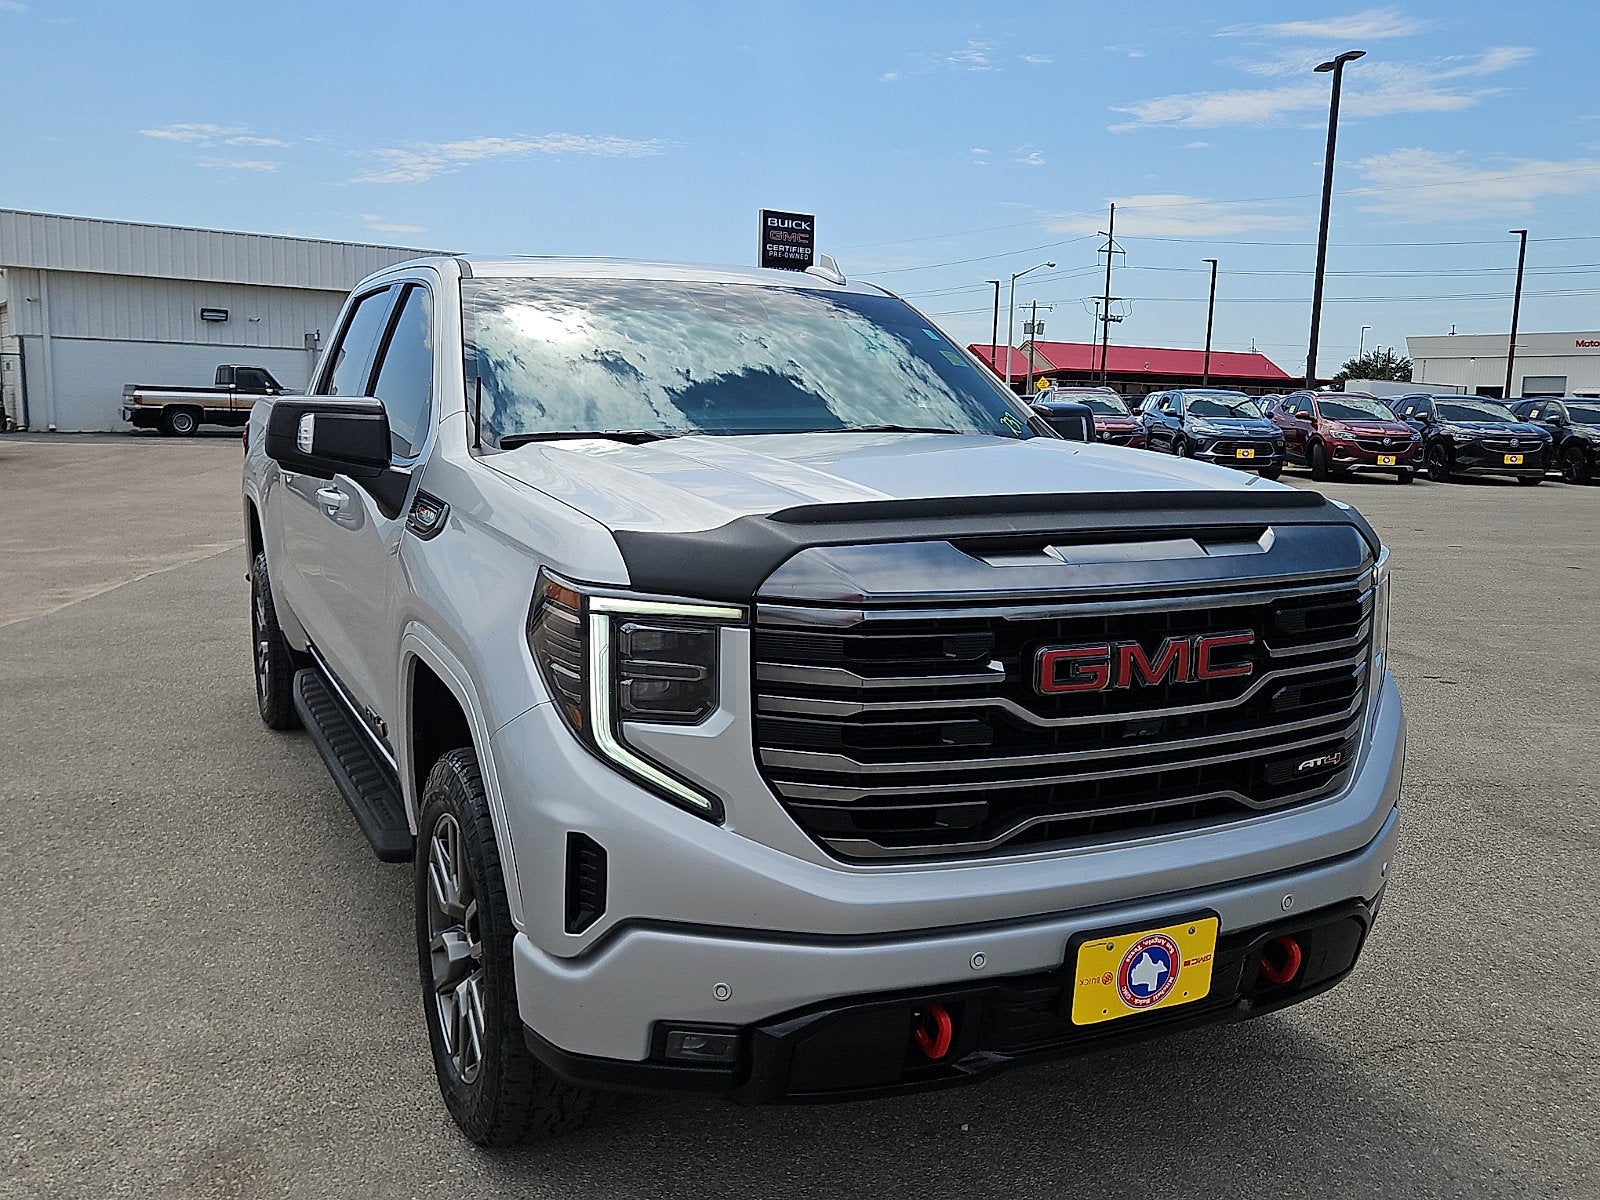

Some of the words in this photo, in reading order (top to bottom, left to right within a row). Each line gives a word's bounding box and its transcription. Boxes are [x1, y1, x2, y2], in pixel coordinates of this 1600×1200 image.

[767, 217, 811, 230] BUICK
[770, 230, 809, 243] GMC
[766, 243, 811, 254] CERTIFIED
[768, 251, 808, 260] PRE-OWNED
[1575, 339, 1600, 348] Moto
[1033, 629, 1255, 695] GMC
[1298, 751, 1341, 771] AT4
[1125, 944, 1142, 963] Texas
[1165, 942, 1175, 955] San
[1190, 954, 1212, 966] GMC
[1079, 976, 1101, 986] BUICK
[1153, 976, 1175, 1001] Mitchell
